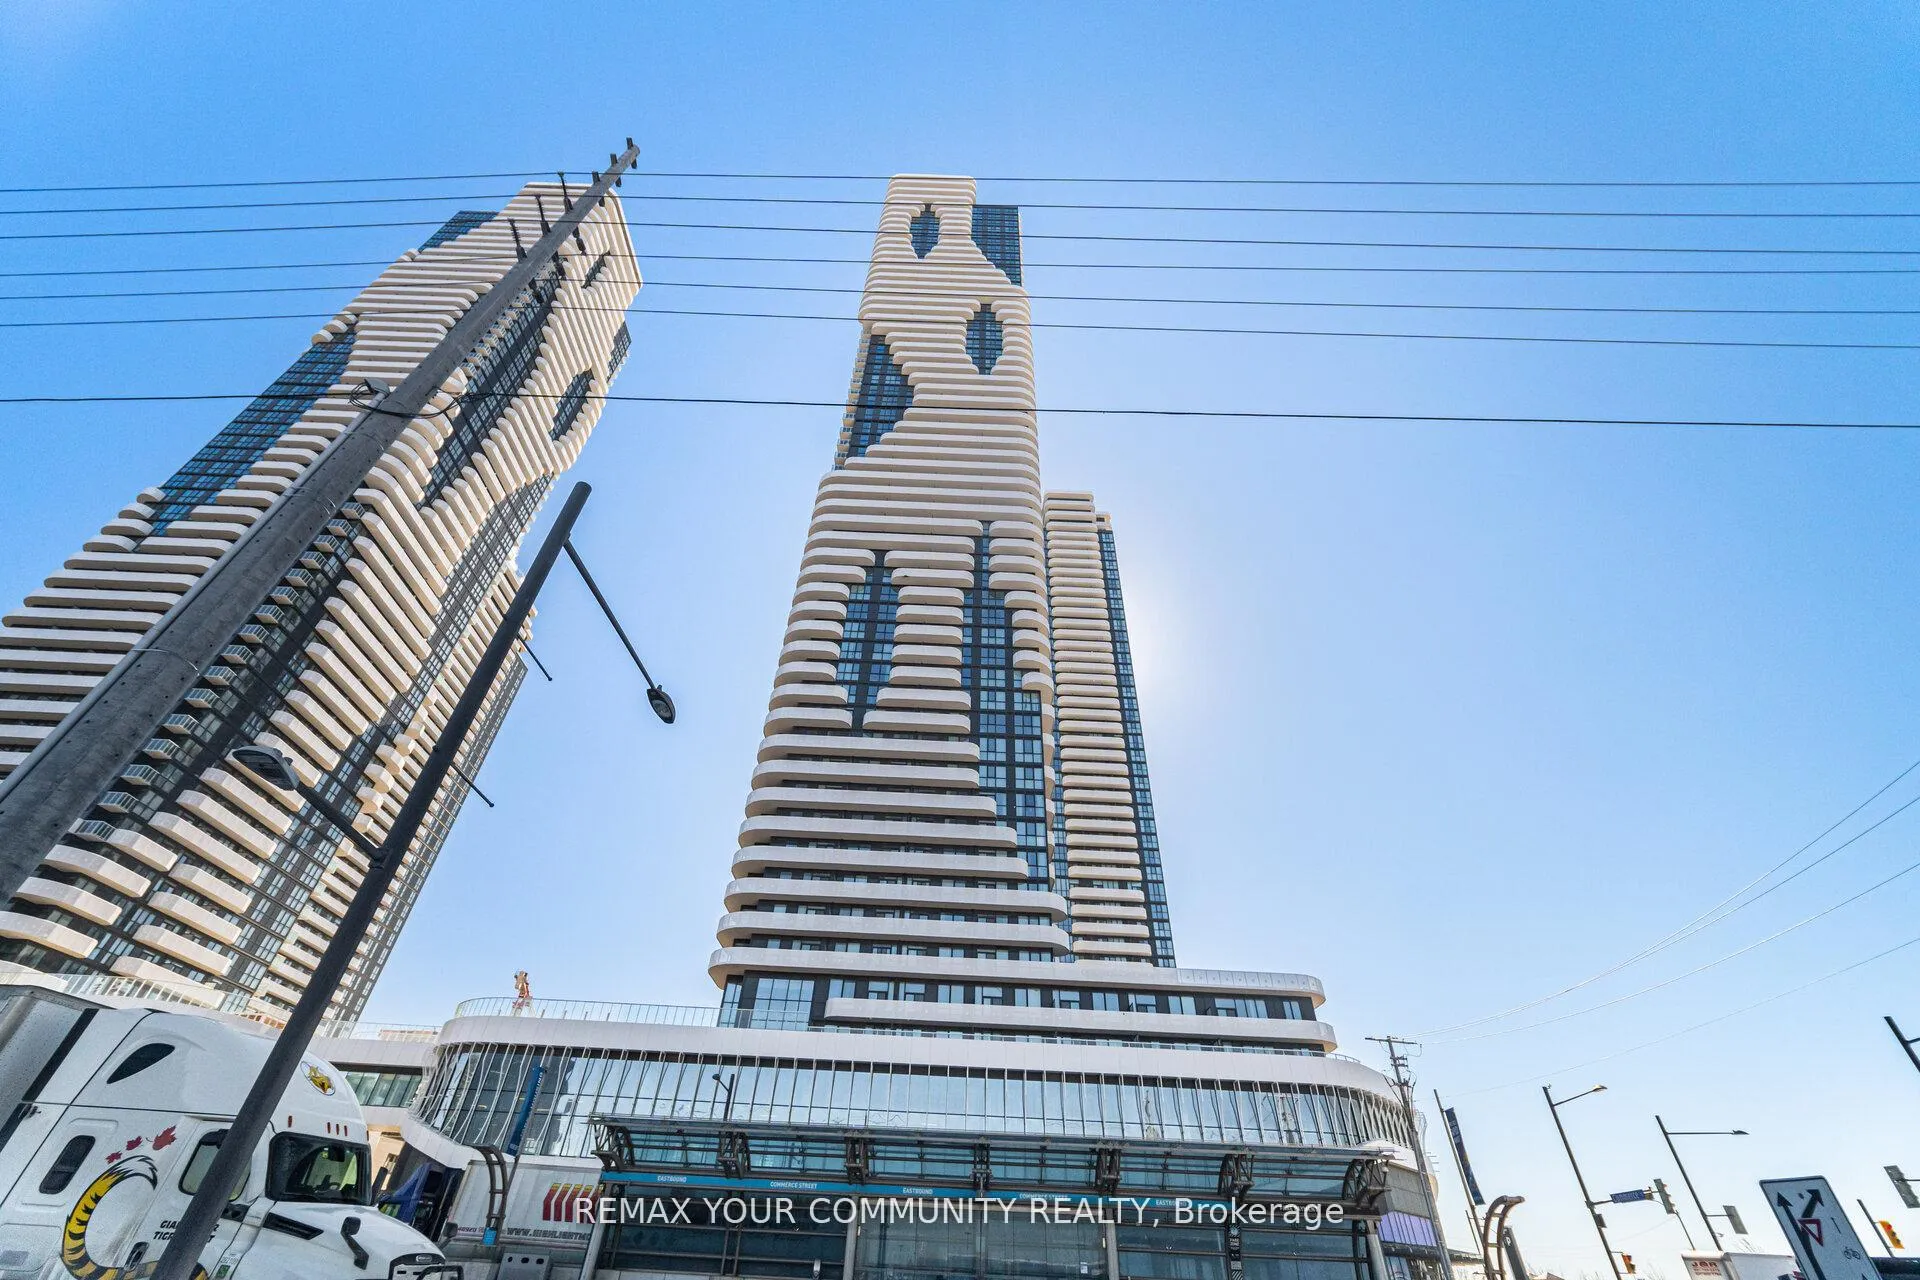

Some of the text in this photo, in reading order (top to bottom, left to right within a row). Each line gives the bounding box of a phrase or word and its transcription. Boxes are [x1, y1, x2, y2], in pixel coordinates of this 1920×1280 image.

[657, 1175, 688, 1183] EASTBOUND
[770, 1181, 798, 1189] COMMERCE
[902, 1187, 933, 1195] EASTBOUND
